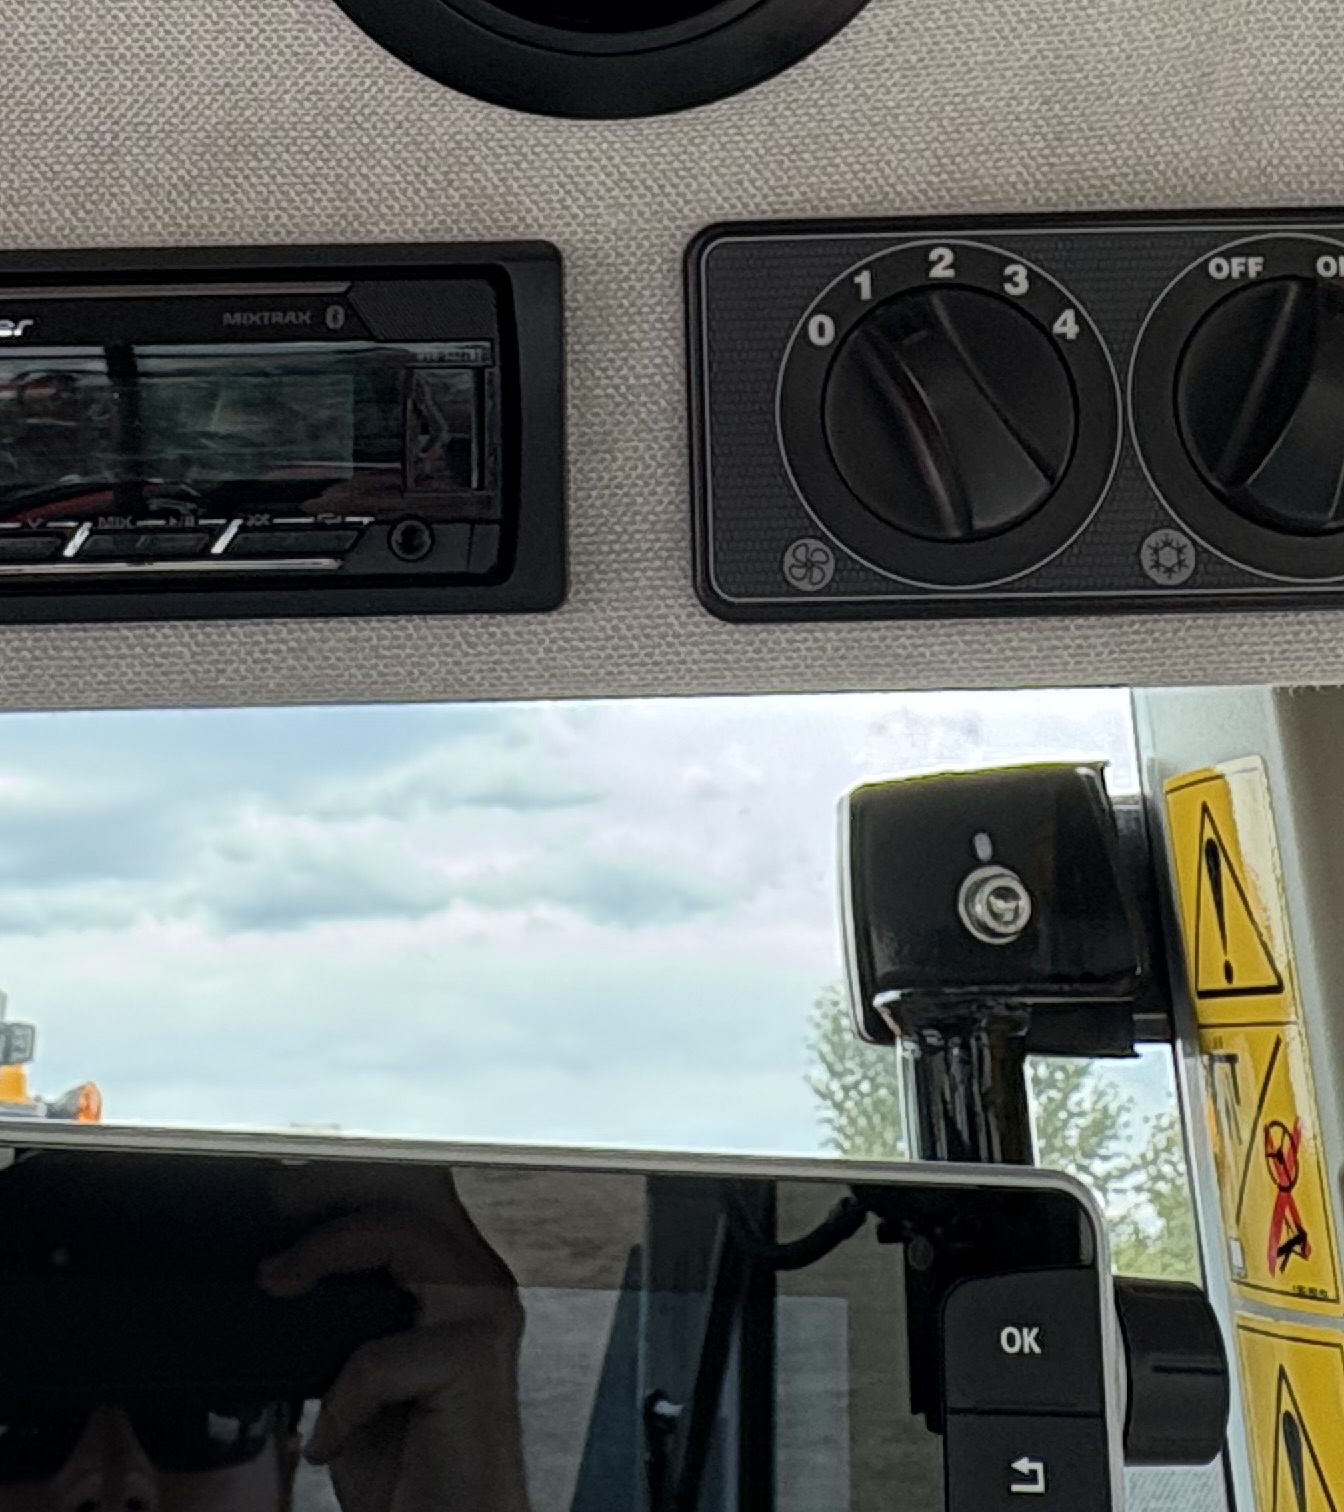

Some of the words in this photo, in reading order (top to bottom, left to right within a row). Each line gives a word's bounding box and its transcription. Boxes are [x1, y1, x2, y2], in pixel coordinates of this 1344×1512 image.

[1208, 256, 1265, 280] OFF
[808, 314, 835, 346] 0
[854, 269, 872, 301] 1
[928, 247, 956, 278] 2
[1003, 264, 1030, 296] 3
[1052, 309, 1080, 340] 4
[222, 310, 312, 326] MIXTRAX
[1000, 1326, 1042, 1354] OK
